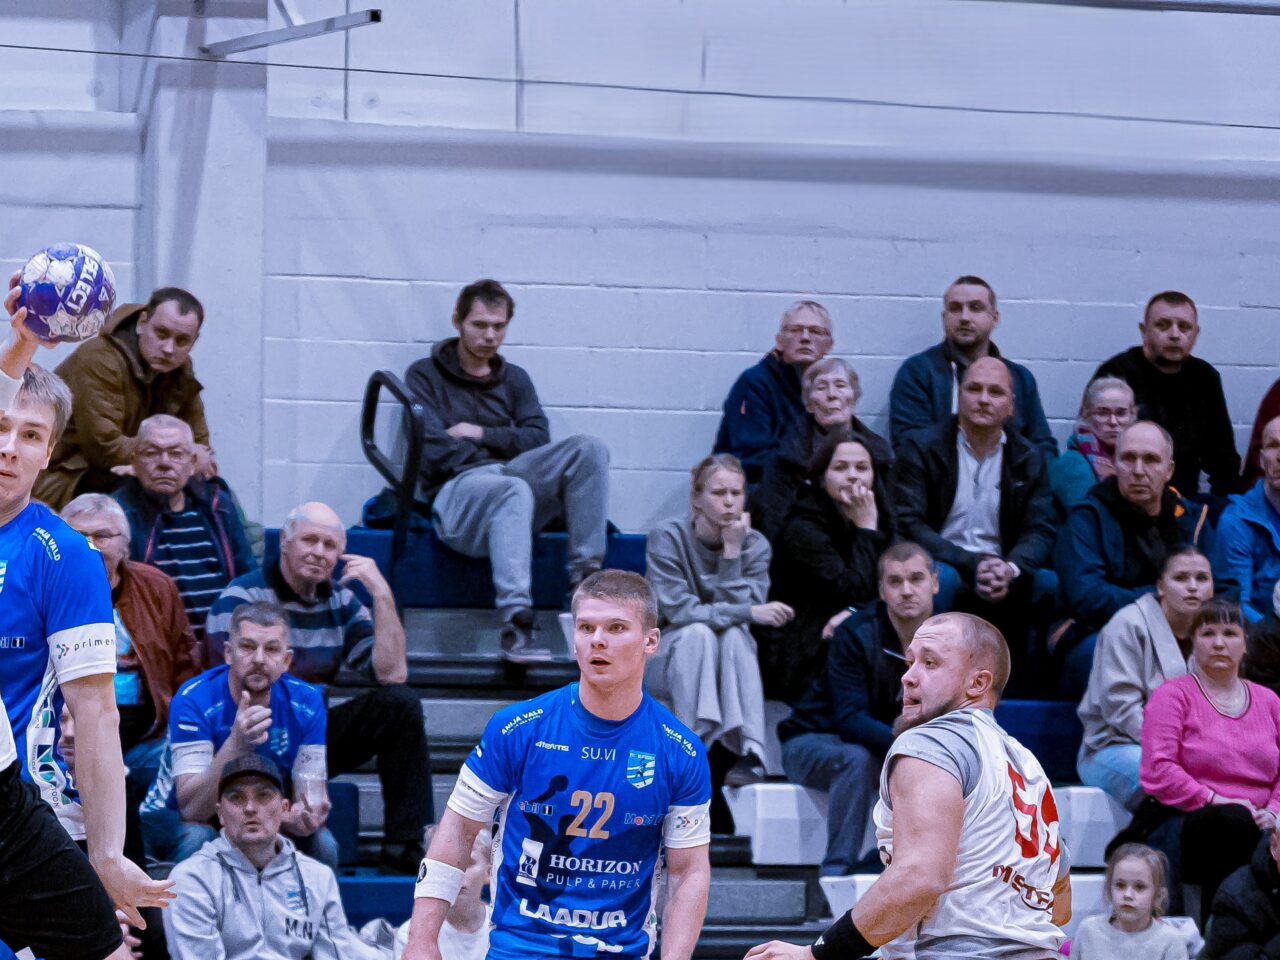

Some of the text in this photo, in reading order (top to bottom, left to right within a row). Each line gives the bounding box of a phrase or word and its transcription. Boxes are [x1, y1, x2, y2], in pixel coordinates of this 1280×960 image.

[48, 537, 61, 562] VALD
[501, 713, 524, 735] ANIJA
[521, 708, 544, 723] VALD
[581, 746, 616, 761] SU.VI
[682, 738, 697, 757] VALD
[566, 790, 615, 839] 22
[549, 854, 643, 875] HORIZON
[546, 873, 641, 890] PULP & PAPER
